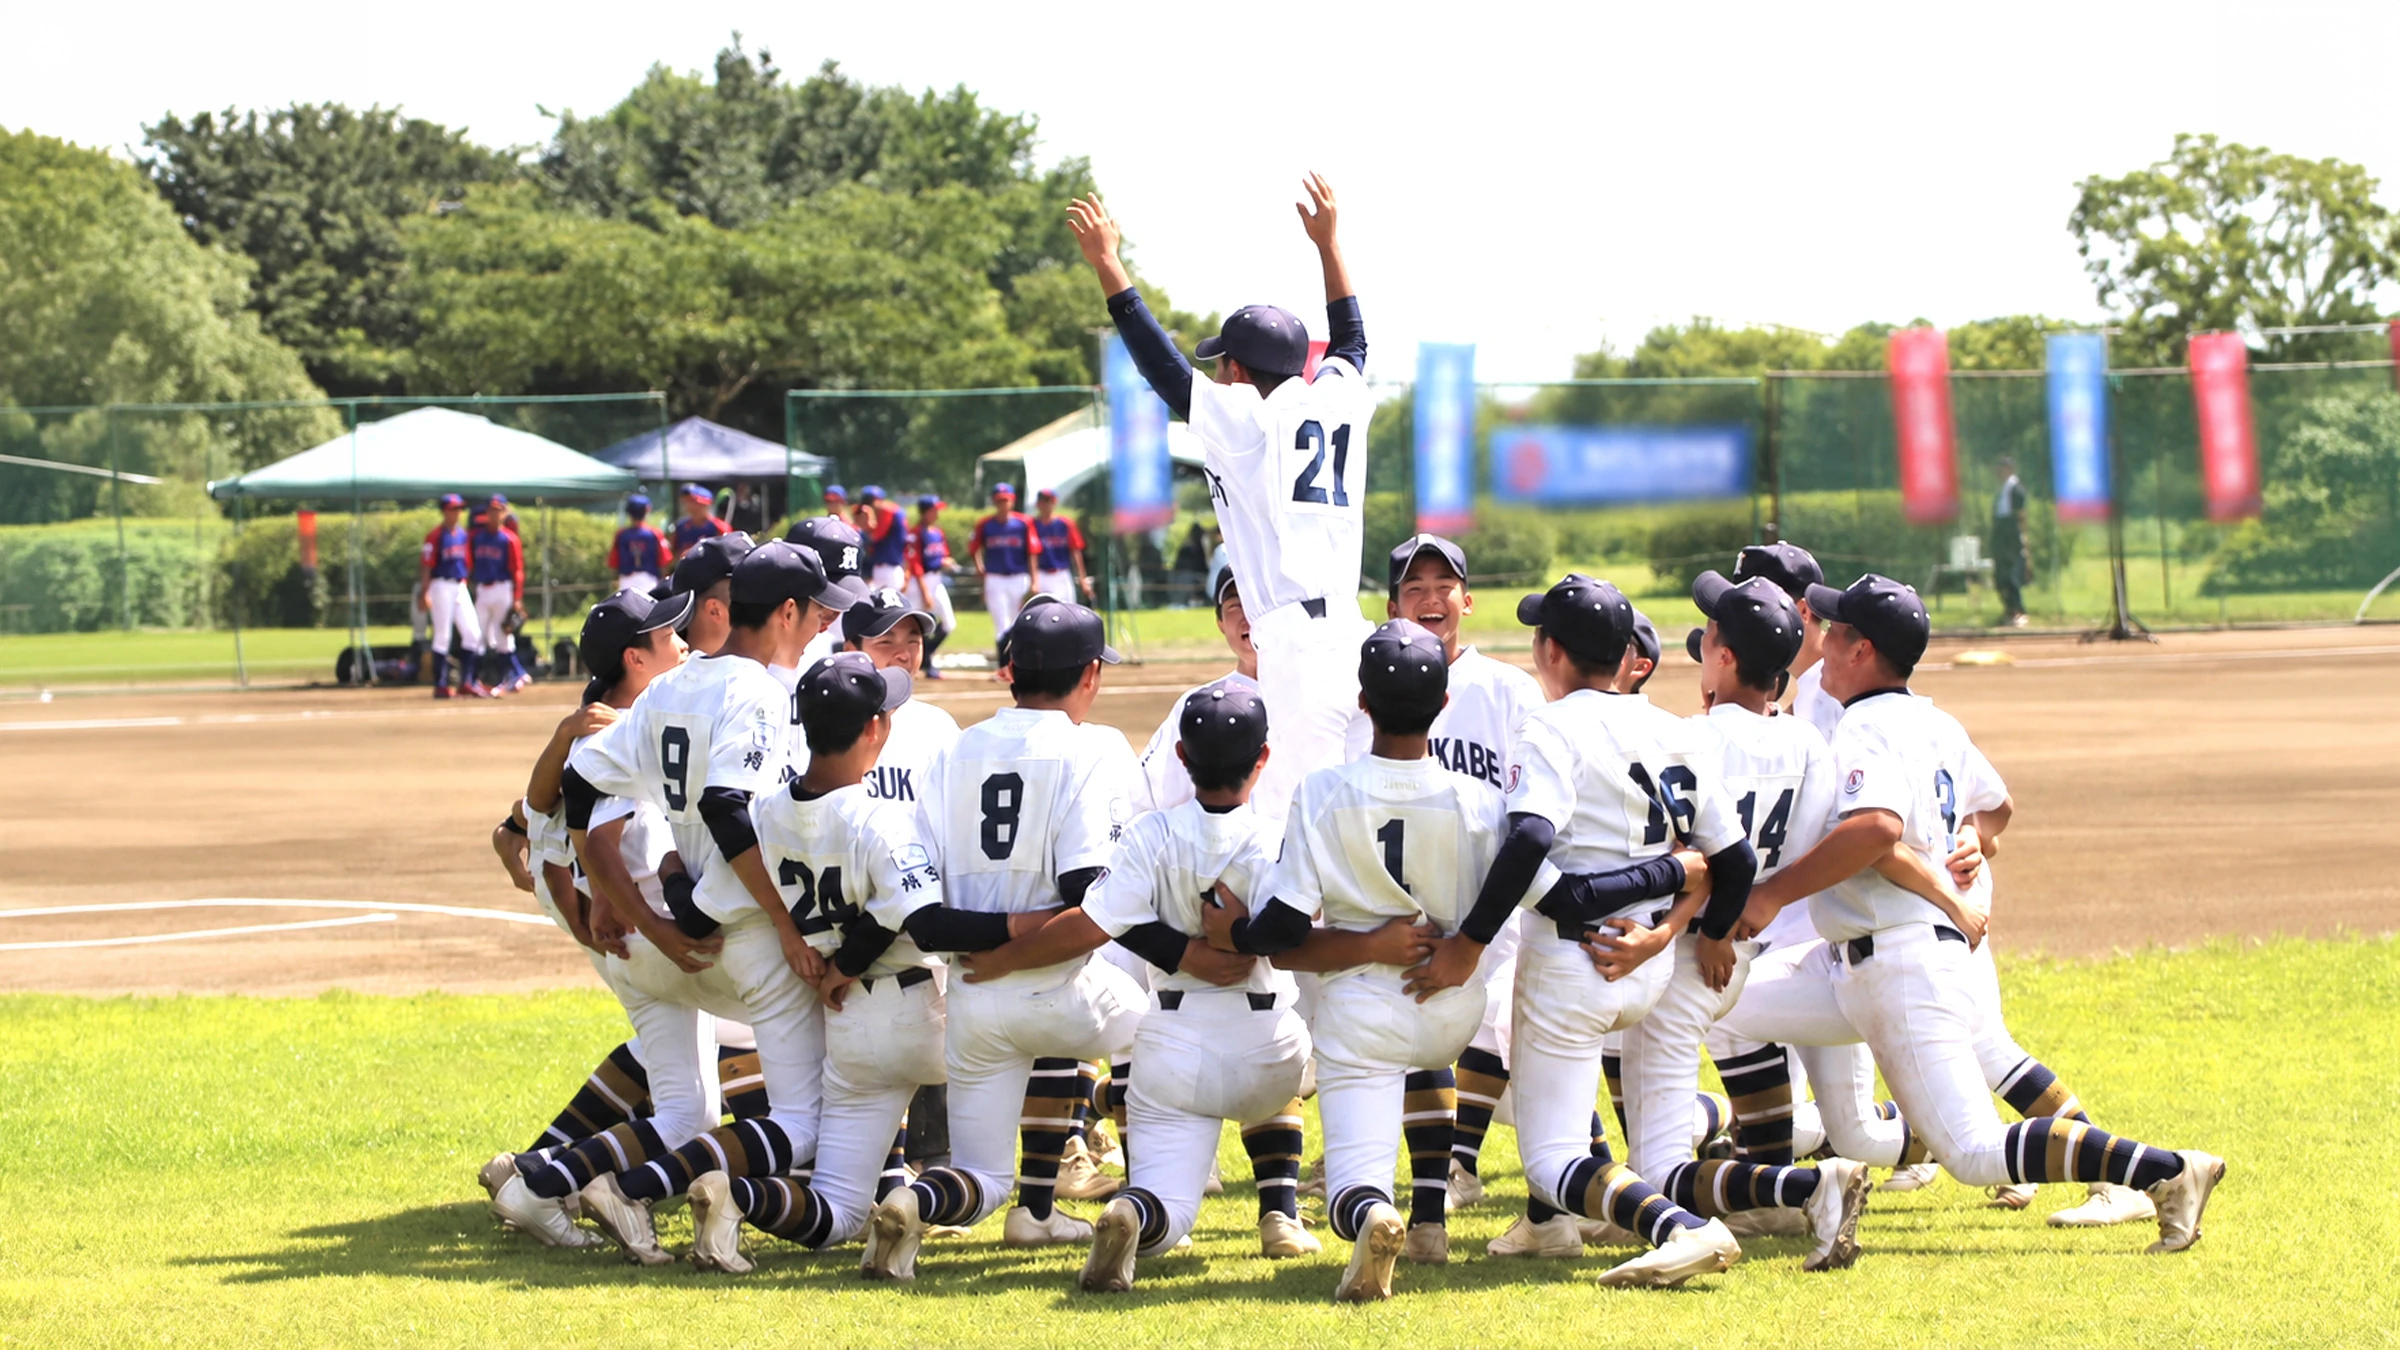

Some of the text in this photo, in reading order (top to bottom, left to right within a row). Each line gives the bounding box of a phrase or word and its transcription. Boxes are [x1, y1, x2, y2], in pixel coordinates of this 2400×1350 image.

[1292, 419, 1350, 507] 21
[661, 725, 691, 812] 9
[1627, 761, 1697, 847] 16
[981, 772, 1024, 861] 8
[1377, 818, 1411, 895] 1
[1736, 788, 1794, 869] 14
[778, 857, 859, 937] 24
